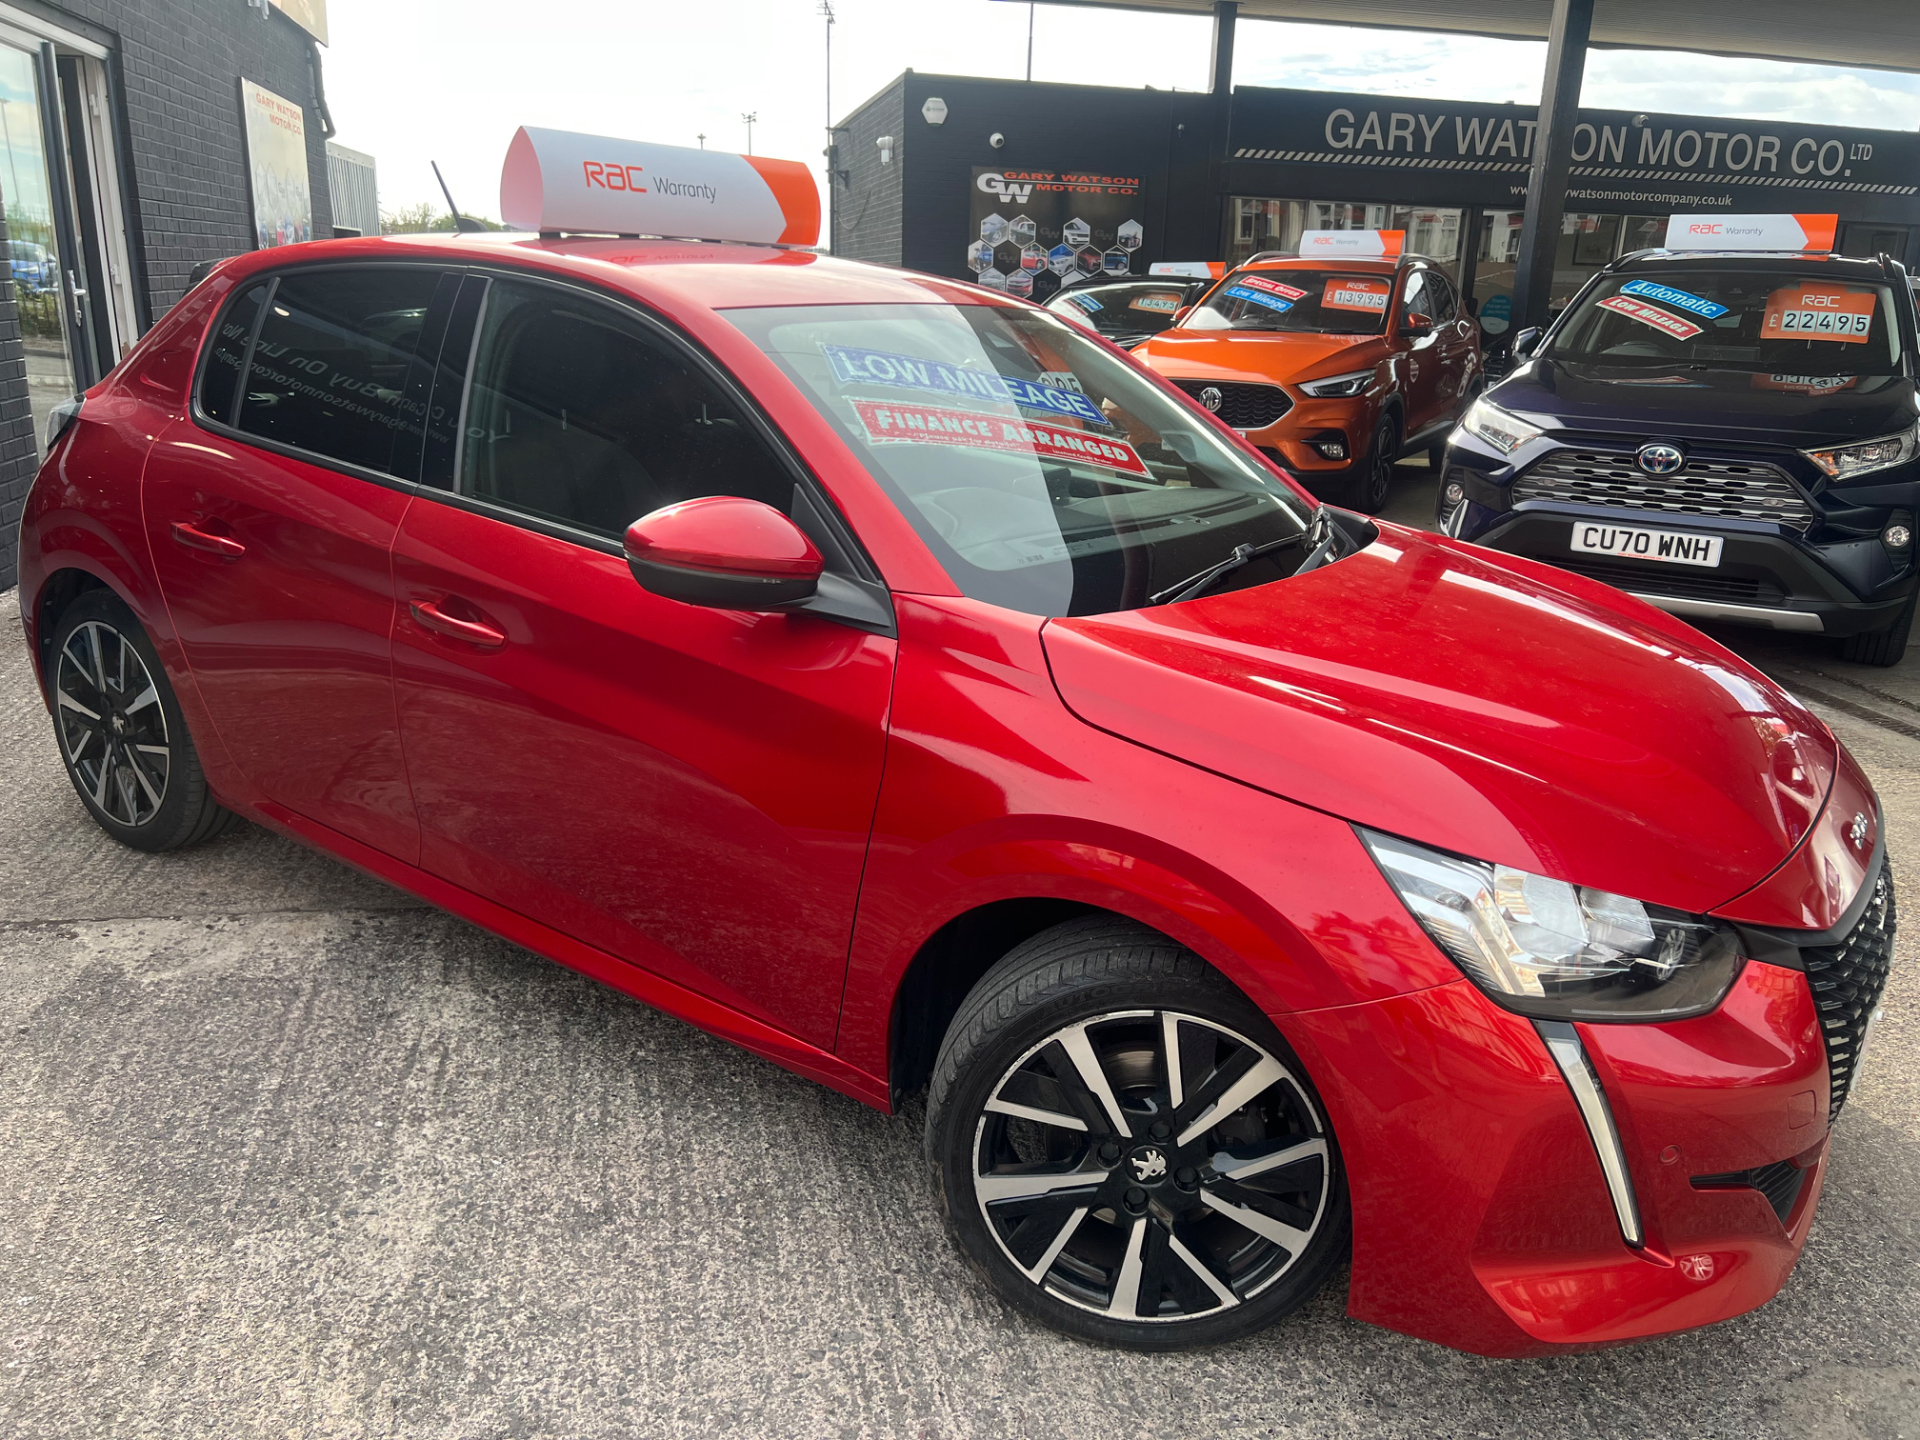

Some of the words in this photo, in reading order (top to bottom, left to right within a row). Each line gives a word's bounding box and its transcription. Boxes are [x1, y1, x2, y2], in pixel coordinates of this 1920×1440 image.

[256, 92, 275, 110] GARY
[276, 102, 302, 122] WATSON
[269, 114, 292, 131] MOTOR
[1324, 108, 1446, 153] GARY
[1455, 116, 1628, 163] WATON
[1637, 128, 1783, 173] MOTOR
[1790, 138, 1852, 177] CO.
[1850, 143, 1873, 161] LTD
[653, 176, 717, 204] Warranty
[976, 172, 1033, 204] GW
[1003, 171, 1056, 182] GARY
[1061, 174, 1140, 186] WATSON
[1036, 184, 1103, 194] MOTOR
[1107, 186, 1139, 196] CO.
[1726, 226, 1764, 237] Warranty
[1230, 287, 1250, 299] Low
[1251, 292, 1288, 309] Mileage
[1275, 285, 1302, 298] OFFER
[1628, 282, 1717, 314] Automatic
[1609, 299, 1640, 312] LOW
[1636, 309, 1689, 333] MILEAGE
[838, 349, 931, 386] LOW
[938, 366, 1098, 418] MILEAGE
[876, 409, 993, 437] FINANCE
[999, 421, 1131, 464] ARRANGED
[1583, 526, 1651, 555] CU70
[1657, 534, 1711, 562] WNH
